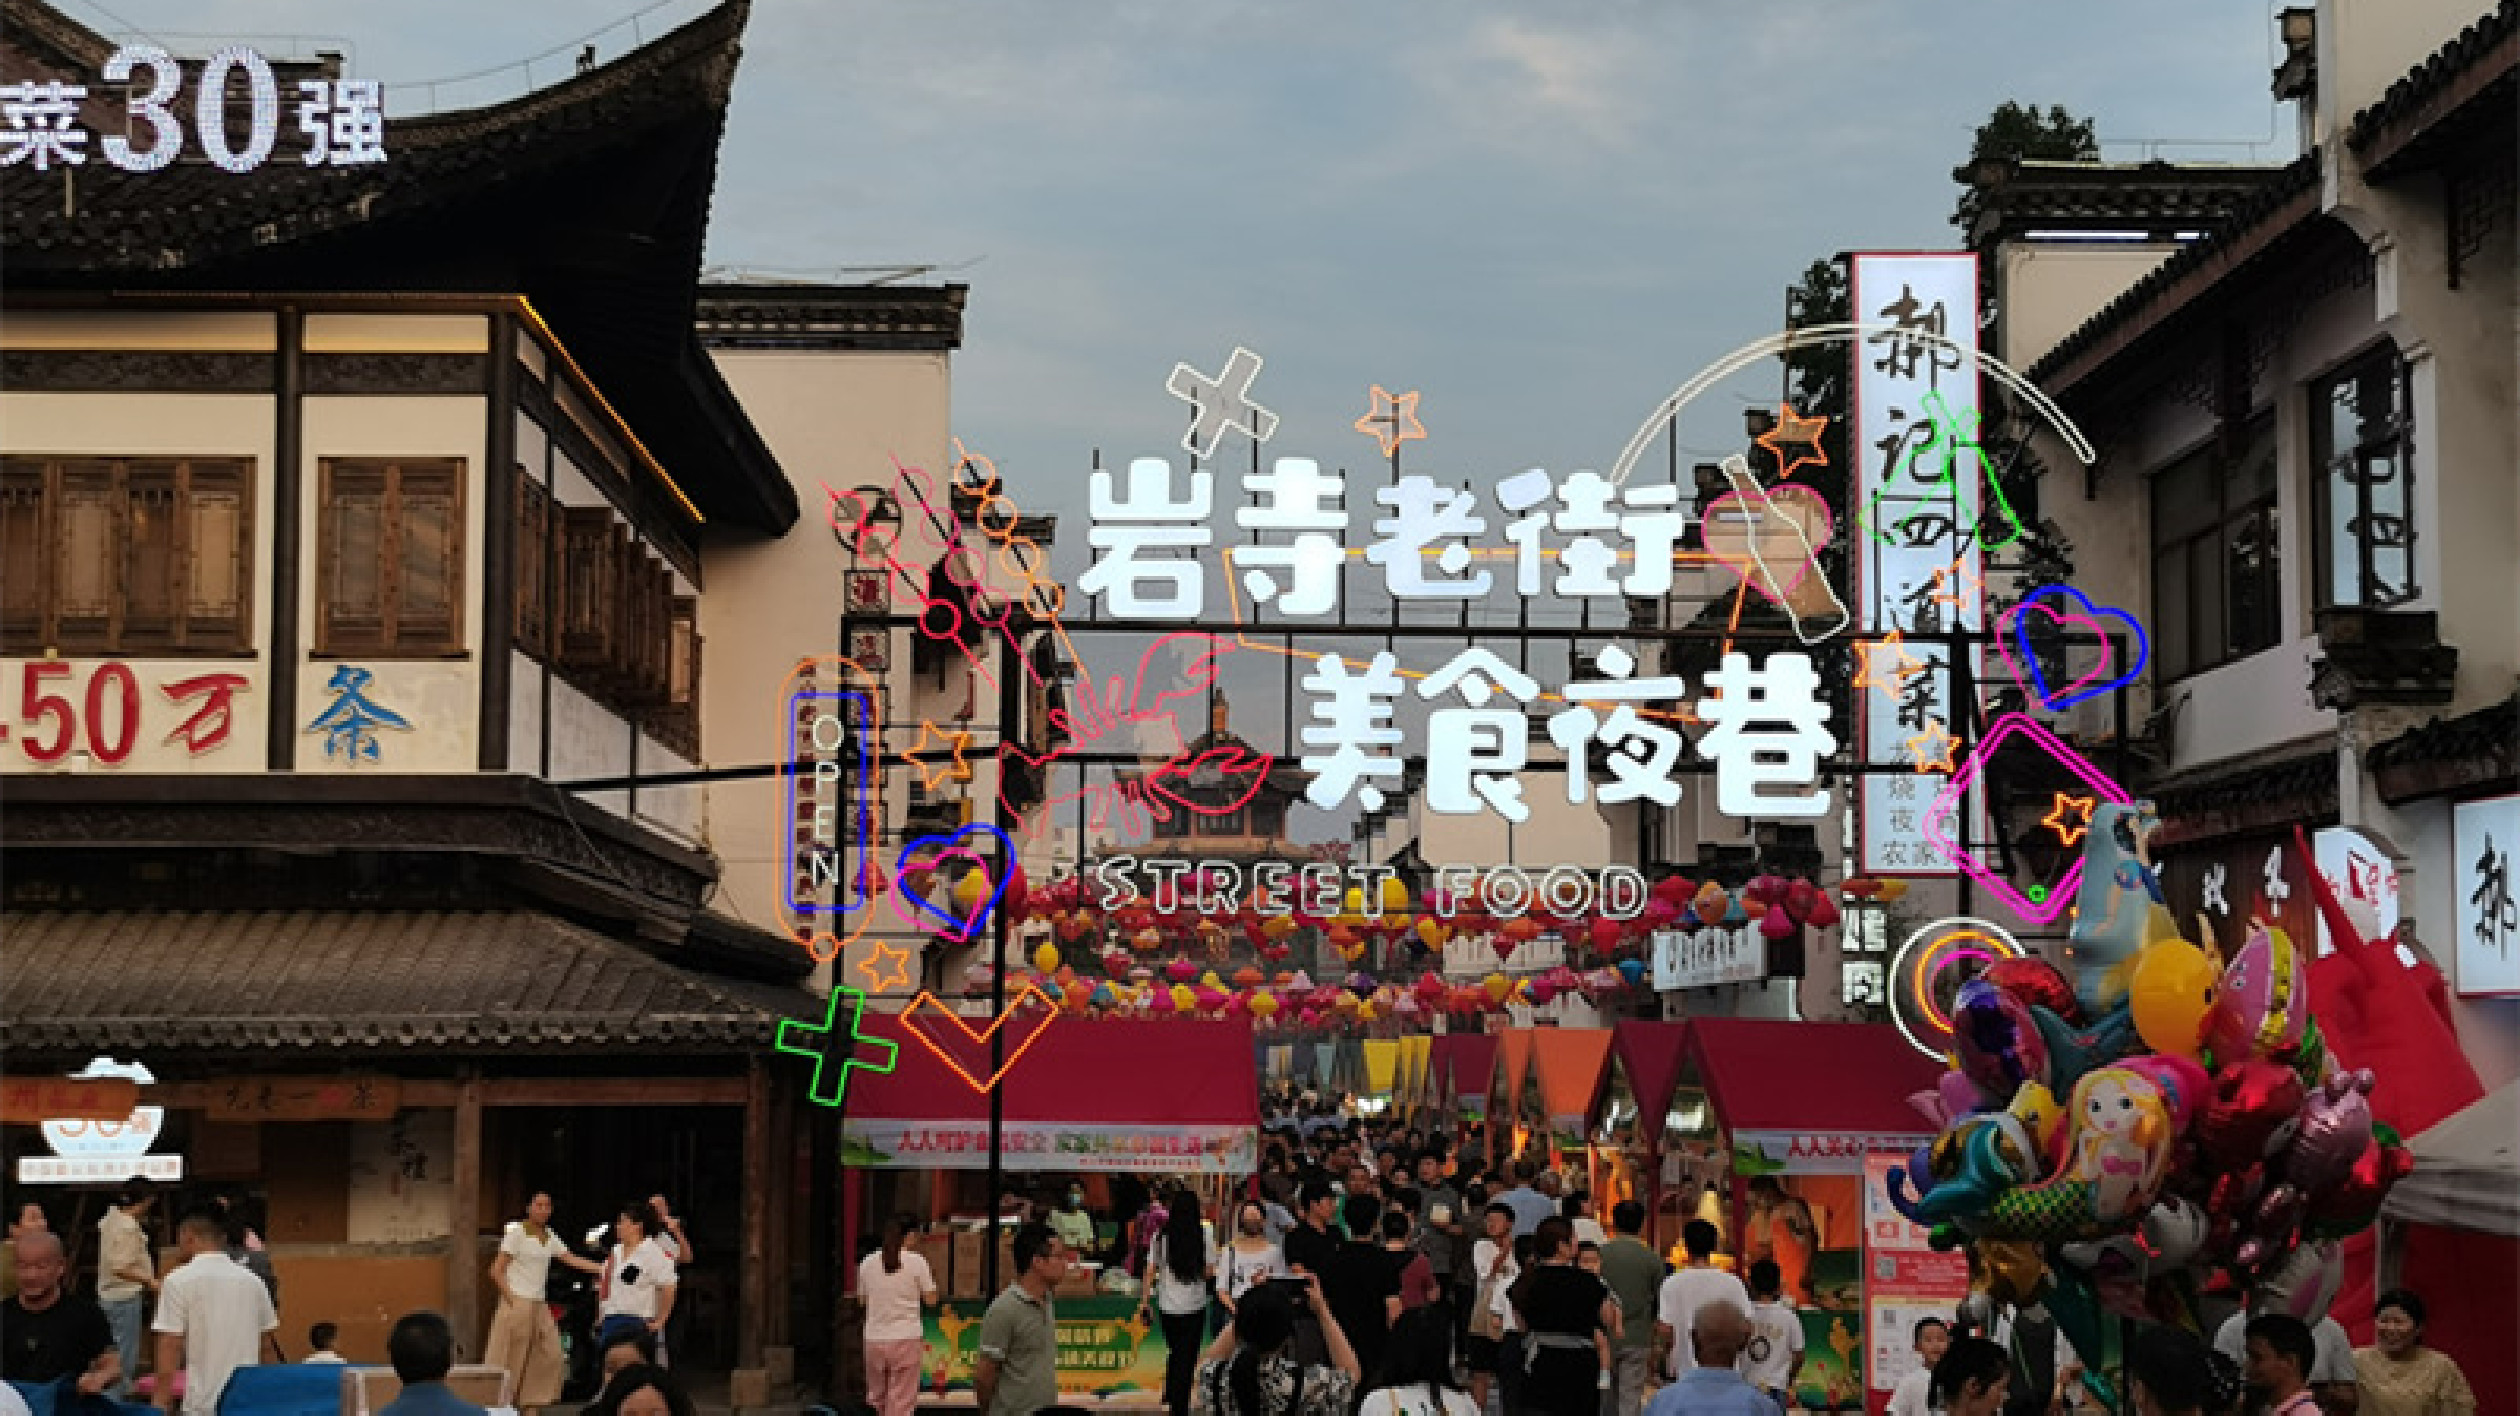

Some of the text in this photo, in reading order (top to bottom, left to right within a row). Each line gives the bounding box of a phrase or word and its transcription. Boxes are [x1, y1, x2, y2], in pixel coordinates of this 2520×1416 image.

[1077, 457, 1684, 618] 岩寺老街
[0, 661, 250, 765] 50万
[1300, 644, 1838, 822] 美食夜巷
[812, 714, 845, 886] OPEN
[1098, 857, 1651, 920] STREET FOOD
